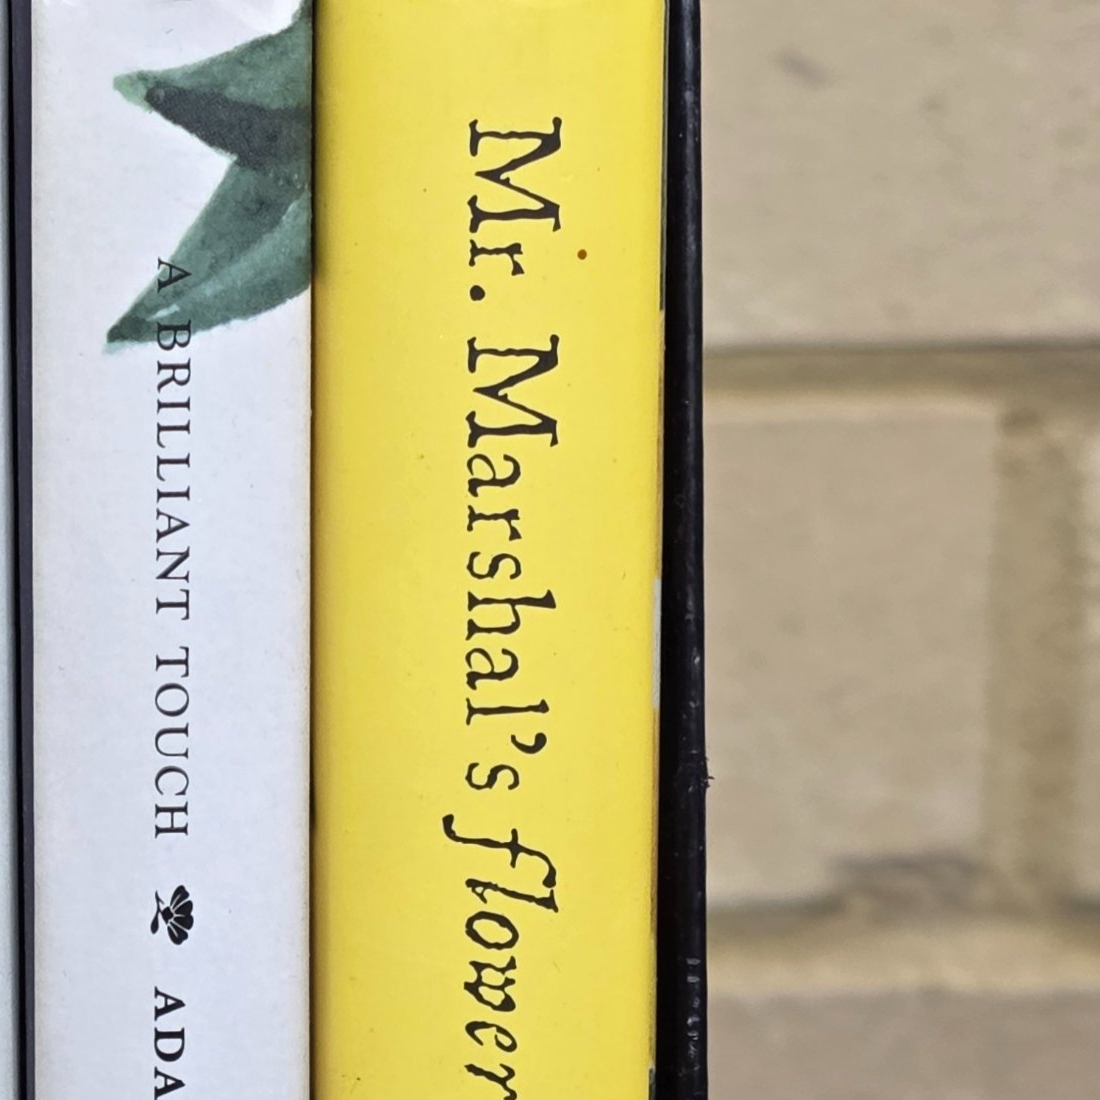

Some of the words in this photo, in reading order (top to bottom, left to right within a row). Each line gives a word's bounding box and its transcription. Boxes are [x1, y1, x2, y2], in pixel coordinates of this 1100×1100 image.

[156, 256, 194, 293] A
[465, 115, 565, 304] Mr.
[154, 318, 194, 622] BRILLIANT
[463, 332, 561, 792] Marshal's
[153, 645, 192, 839] TOUCH
